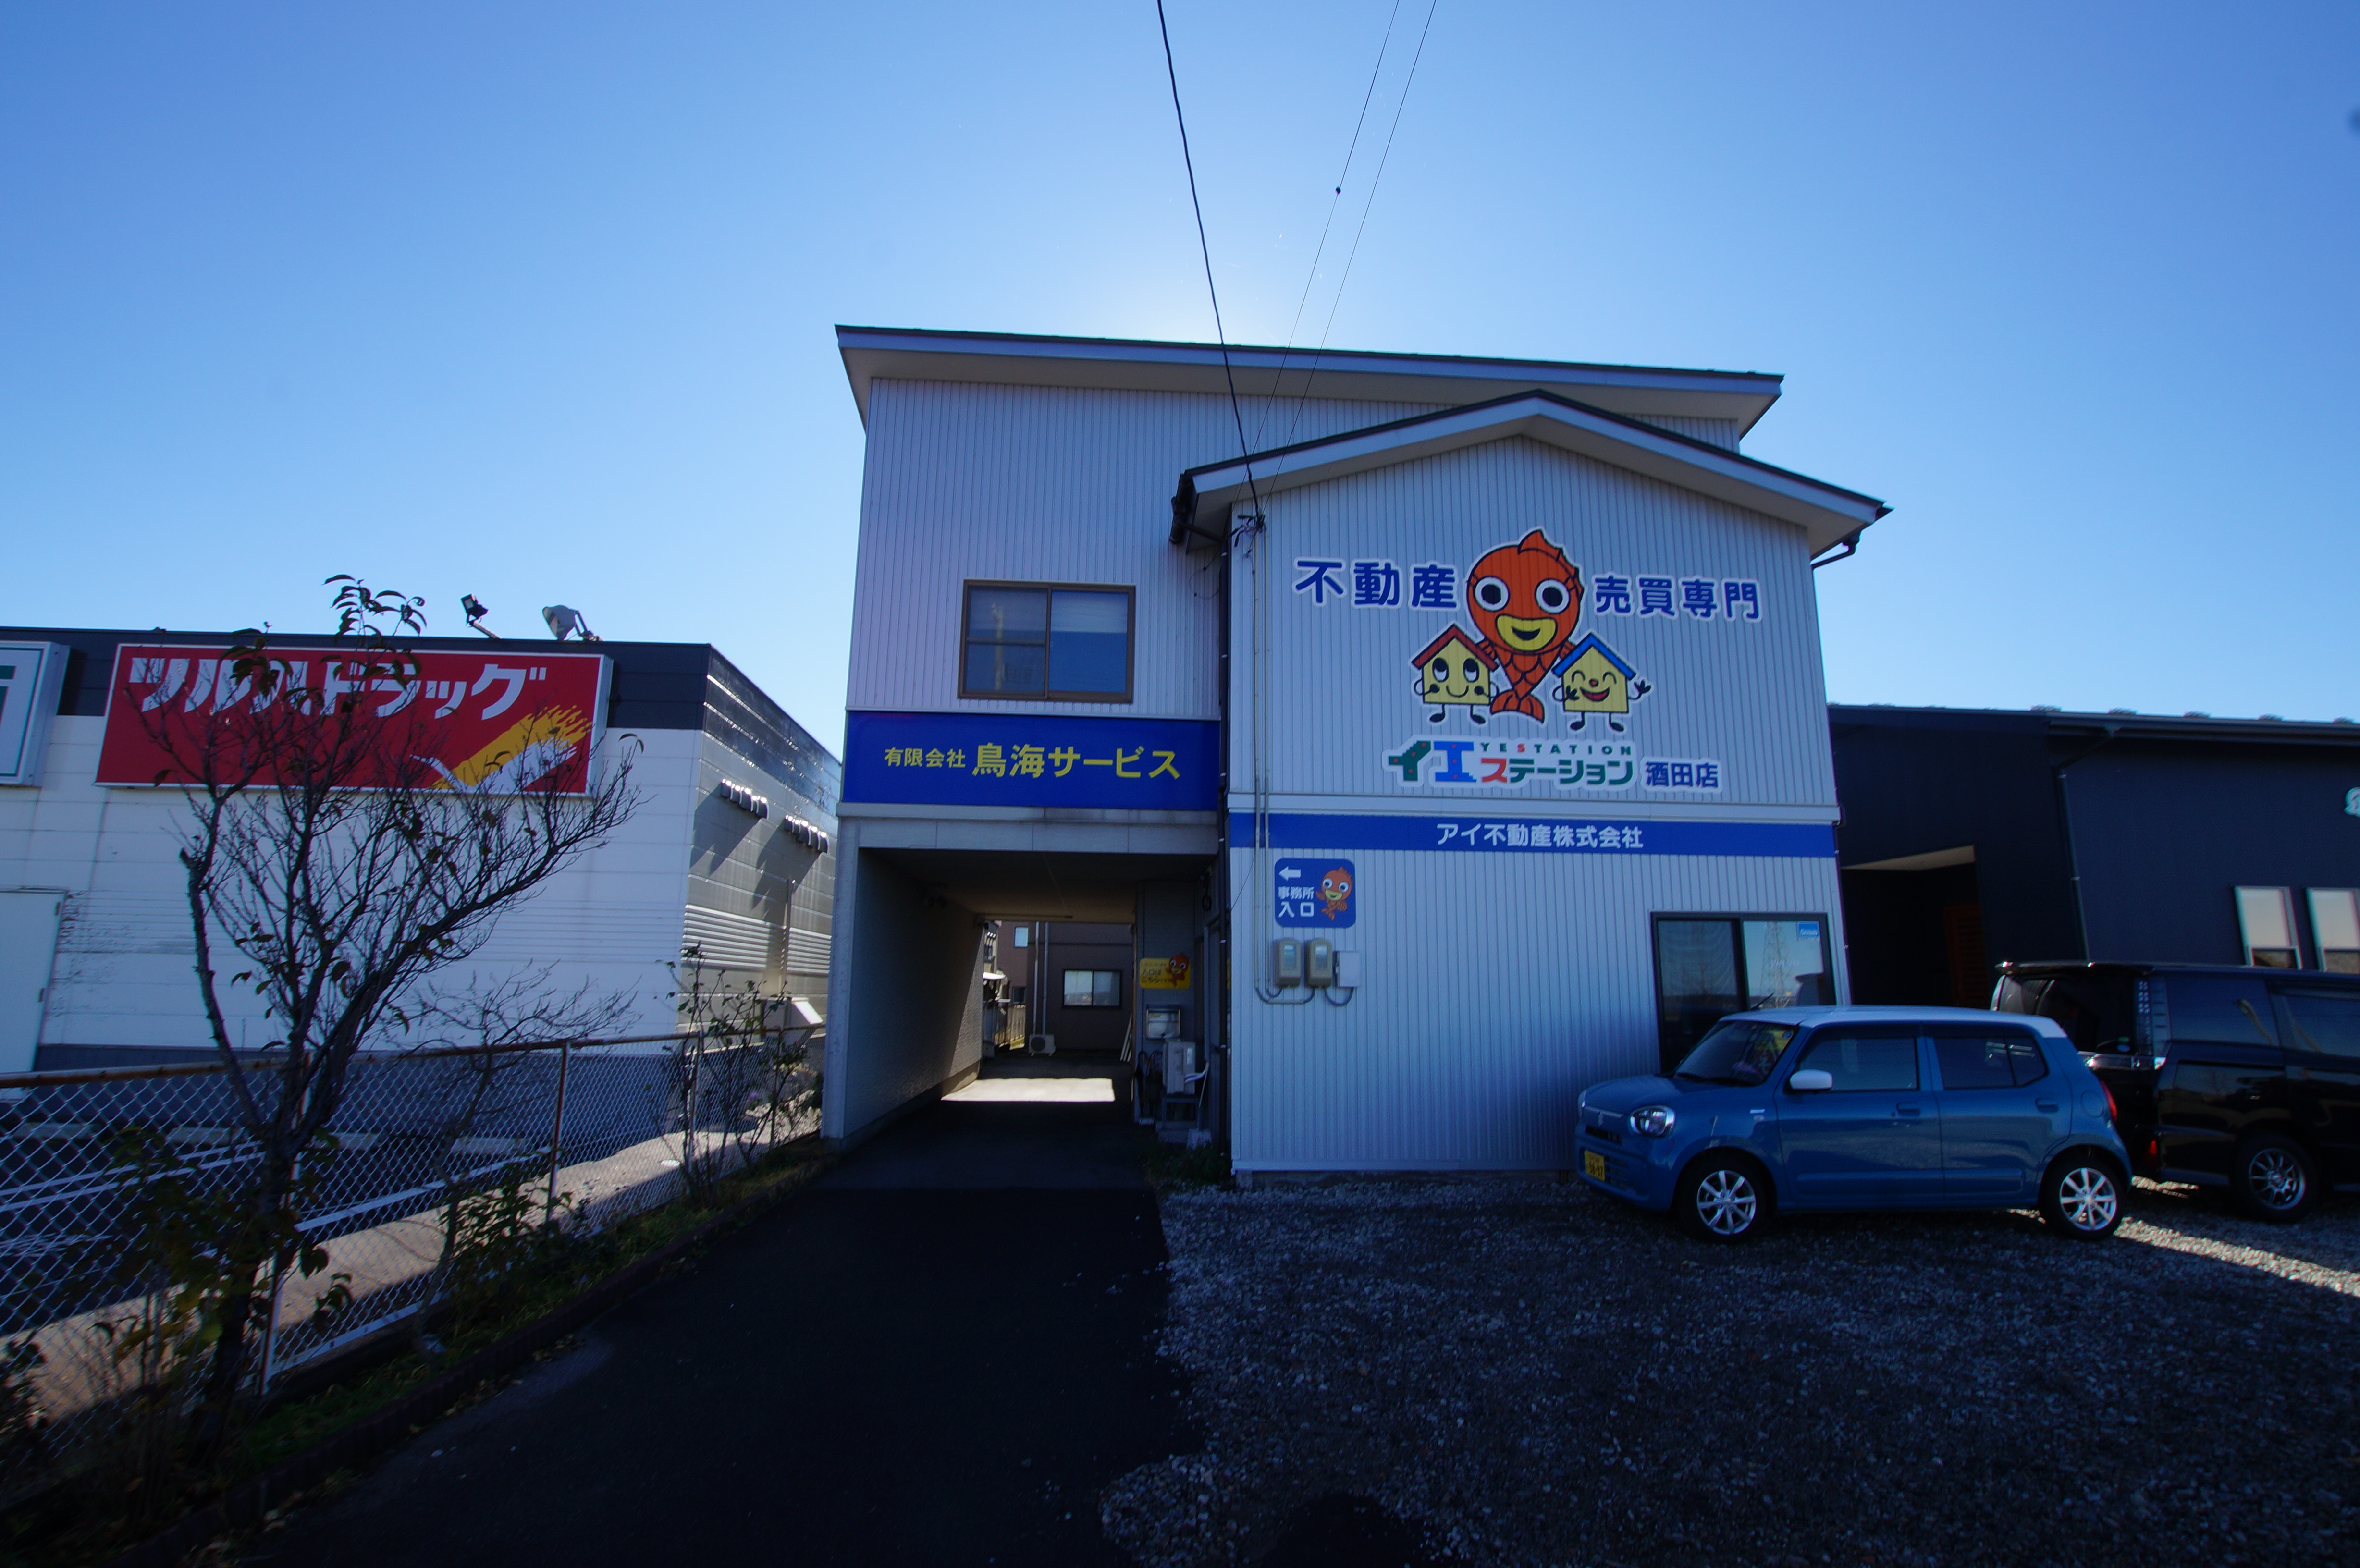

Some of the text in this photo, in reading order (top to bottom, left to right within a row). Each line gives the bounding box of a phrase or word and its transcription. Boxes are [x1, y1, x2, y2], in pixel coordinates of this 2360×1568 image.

[1295, 560, 1760, 619] 不動産 売買専門
[884, 742, 1180, 779] 有限会社 鳥海サービス
[1480, 742, 1632, 756] YESTATION
[1646, 761, 1719, 788] 酒田店
[1437, 823, 1644, 849] アイ不動産株式会社
[1277, 885, 1315, 900] 事務所
[1278, 901, 1315, 918] 入口
